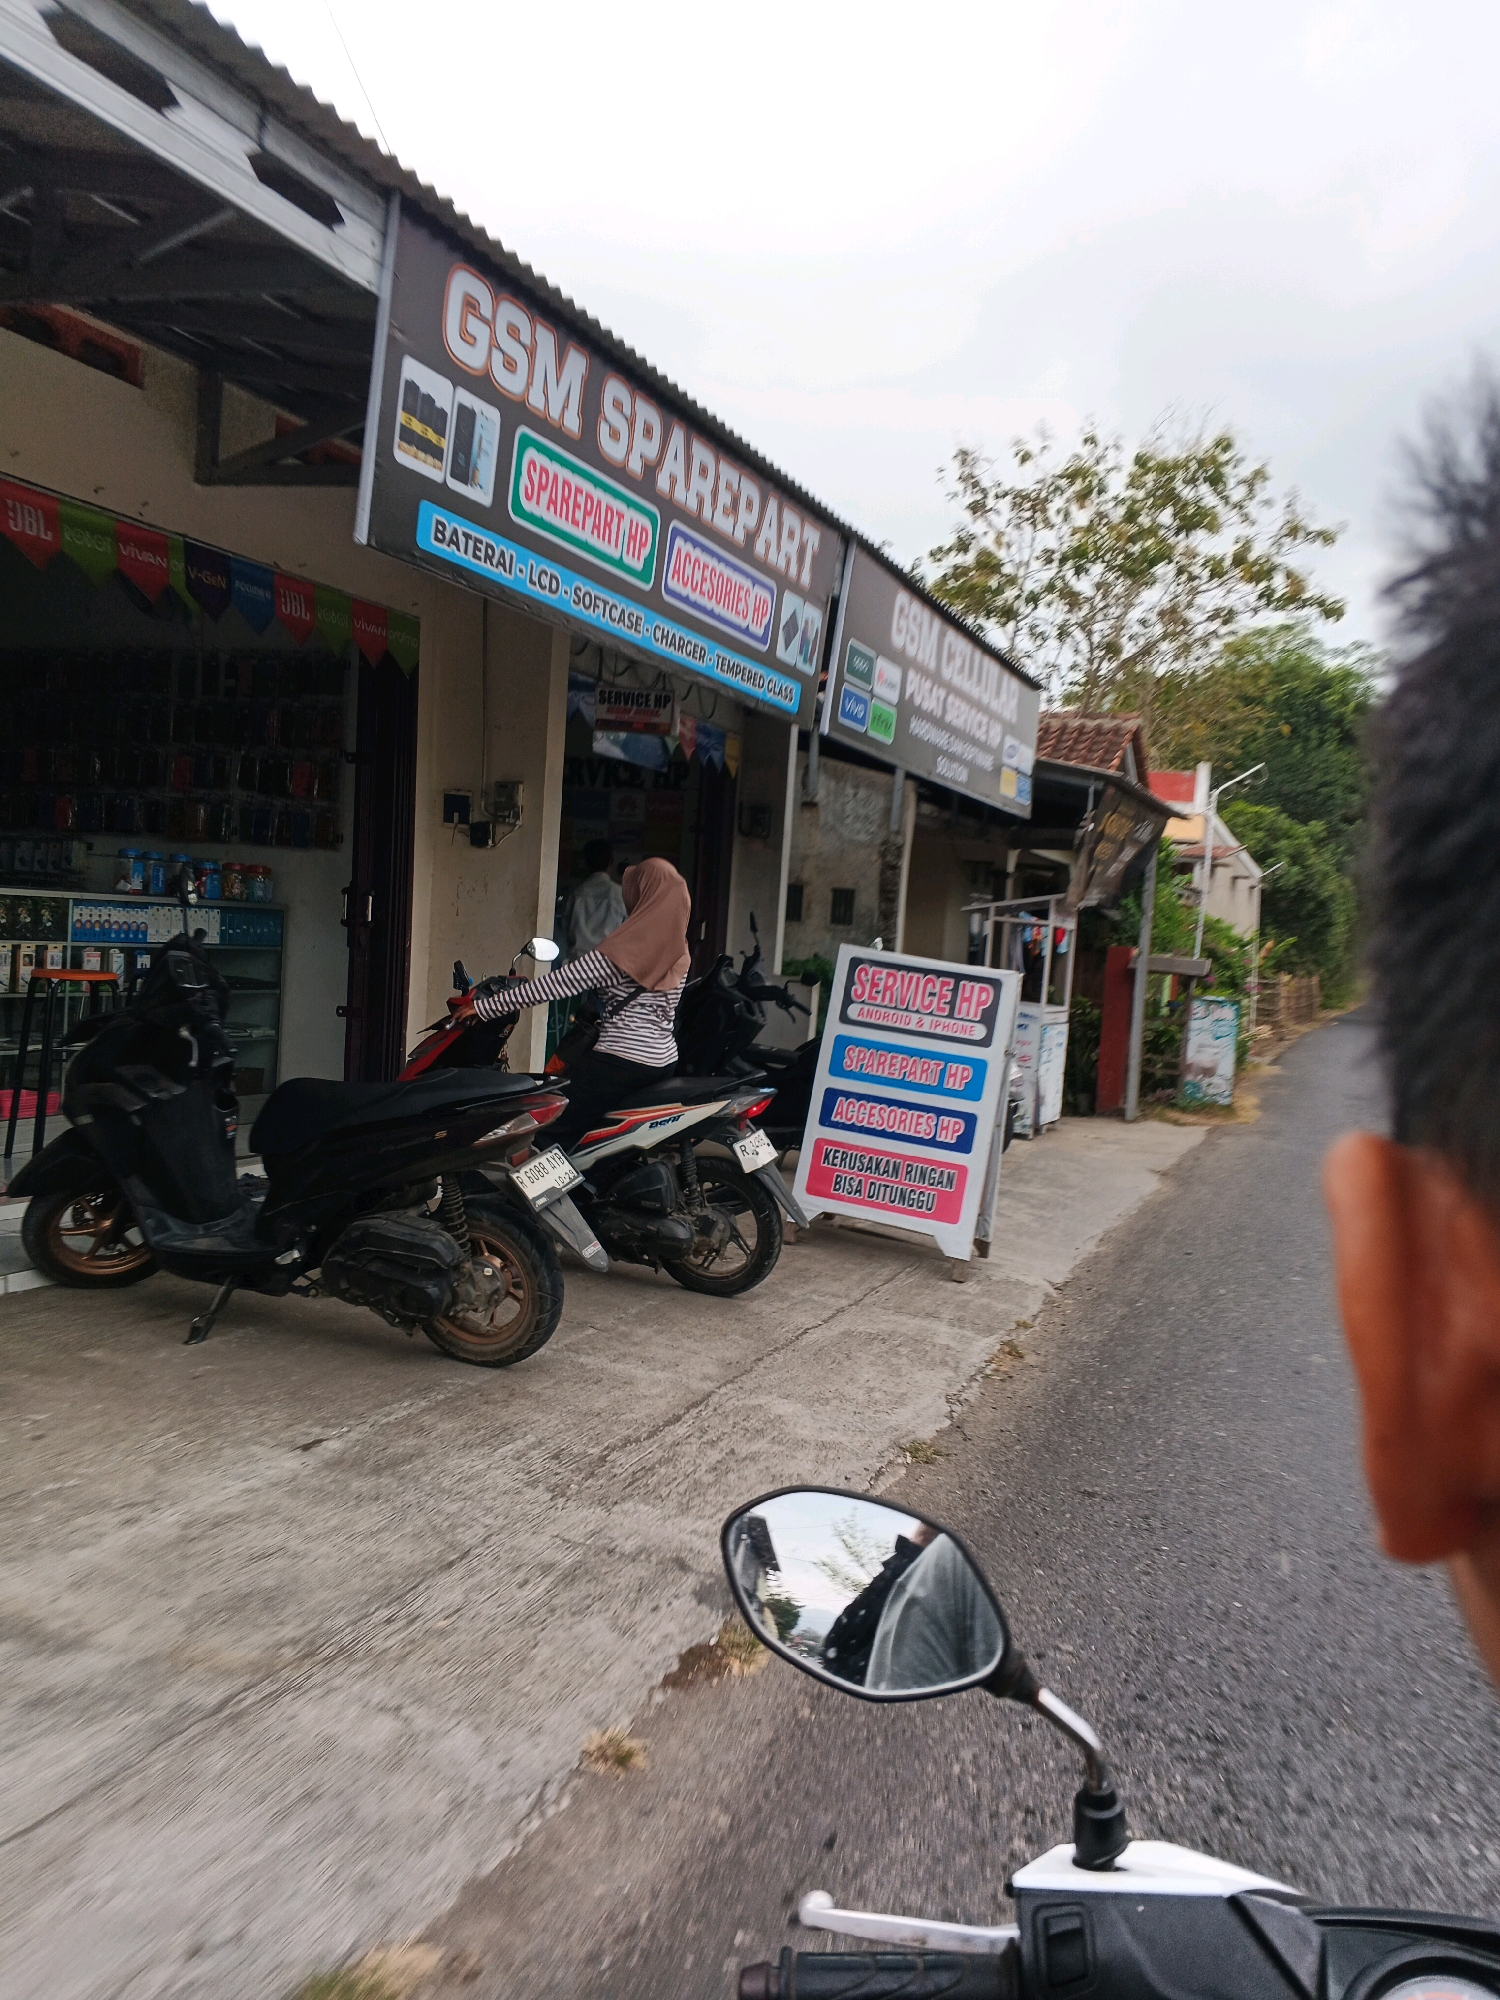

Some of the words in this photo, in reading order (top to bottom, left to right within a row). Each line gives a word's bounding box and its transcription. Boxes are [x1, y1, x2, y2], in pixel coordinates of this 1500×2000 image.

[443, 262, 589, 439] GSM
[597, 372, 820, 590] SPAREPART
[8, 500, 53, 541] JBL
[524, 458, 624, 546] SPAREPART
[625, 518, 651, 565] HP
[280, 588, 310, 621] JBL
[671, 544, 751, 621] ACCESORIES
[753, 592, 769, 629] HP
[431, 517, 515, 577] BATERAI
[527, 561, 560, 596] LCD
[571, 583, 643, 635] SOFTCASE
[653, 623, 707, 667] CHARGER
[715, 652, 765, 690] TEMPERED
[767, 676, 795, 704] GLASS
[891, 588, 941, 672] GSM
[941, 629, 1020, 724] CELLULAR
[598, 689, 650, 710] SERVICE
[653, 692, 672, 710] HP
[905, 668, 948, 717] PUSAT
[852, 965, 951, 1015] SERVICE
[957, 982, 994, 1021] HP
[856, 1008, 911, 1028] ANDROID
[915, 1017, 925, 1028] &
[929, 1018, 976, 1037] IPHONE
[844, 1046, 943, 1086] SPAREPART
[946, 1064, 972, 1090] HP
[834, 1097, 935, 1140] ACCESORIES
[938, 1117, 965, 1144] HP
[516, 1176, 528, 1189] R
[524, 1161, 549, 1184] 6088
[546, 1152, 566, 1170] AYB
[822, 1147, 900, 1180] KERUSAKAN
[904, 1161, 956, 1191] RINGAN
[833, 1174, 863, 1198] BISA
[867, 1180, 937, 1212] DITUNGGU
